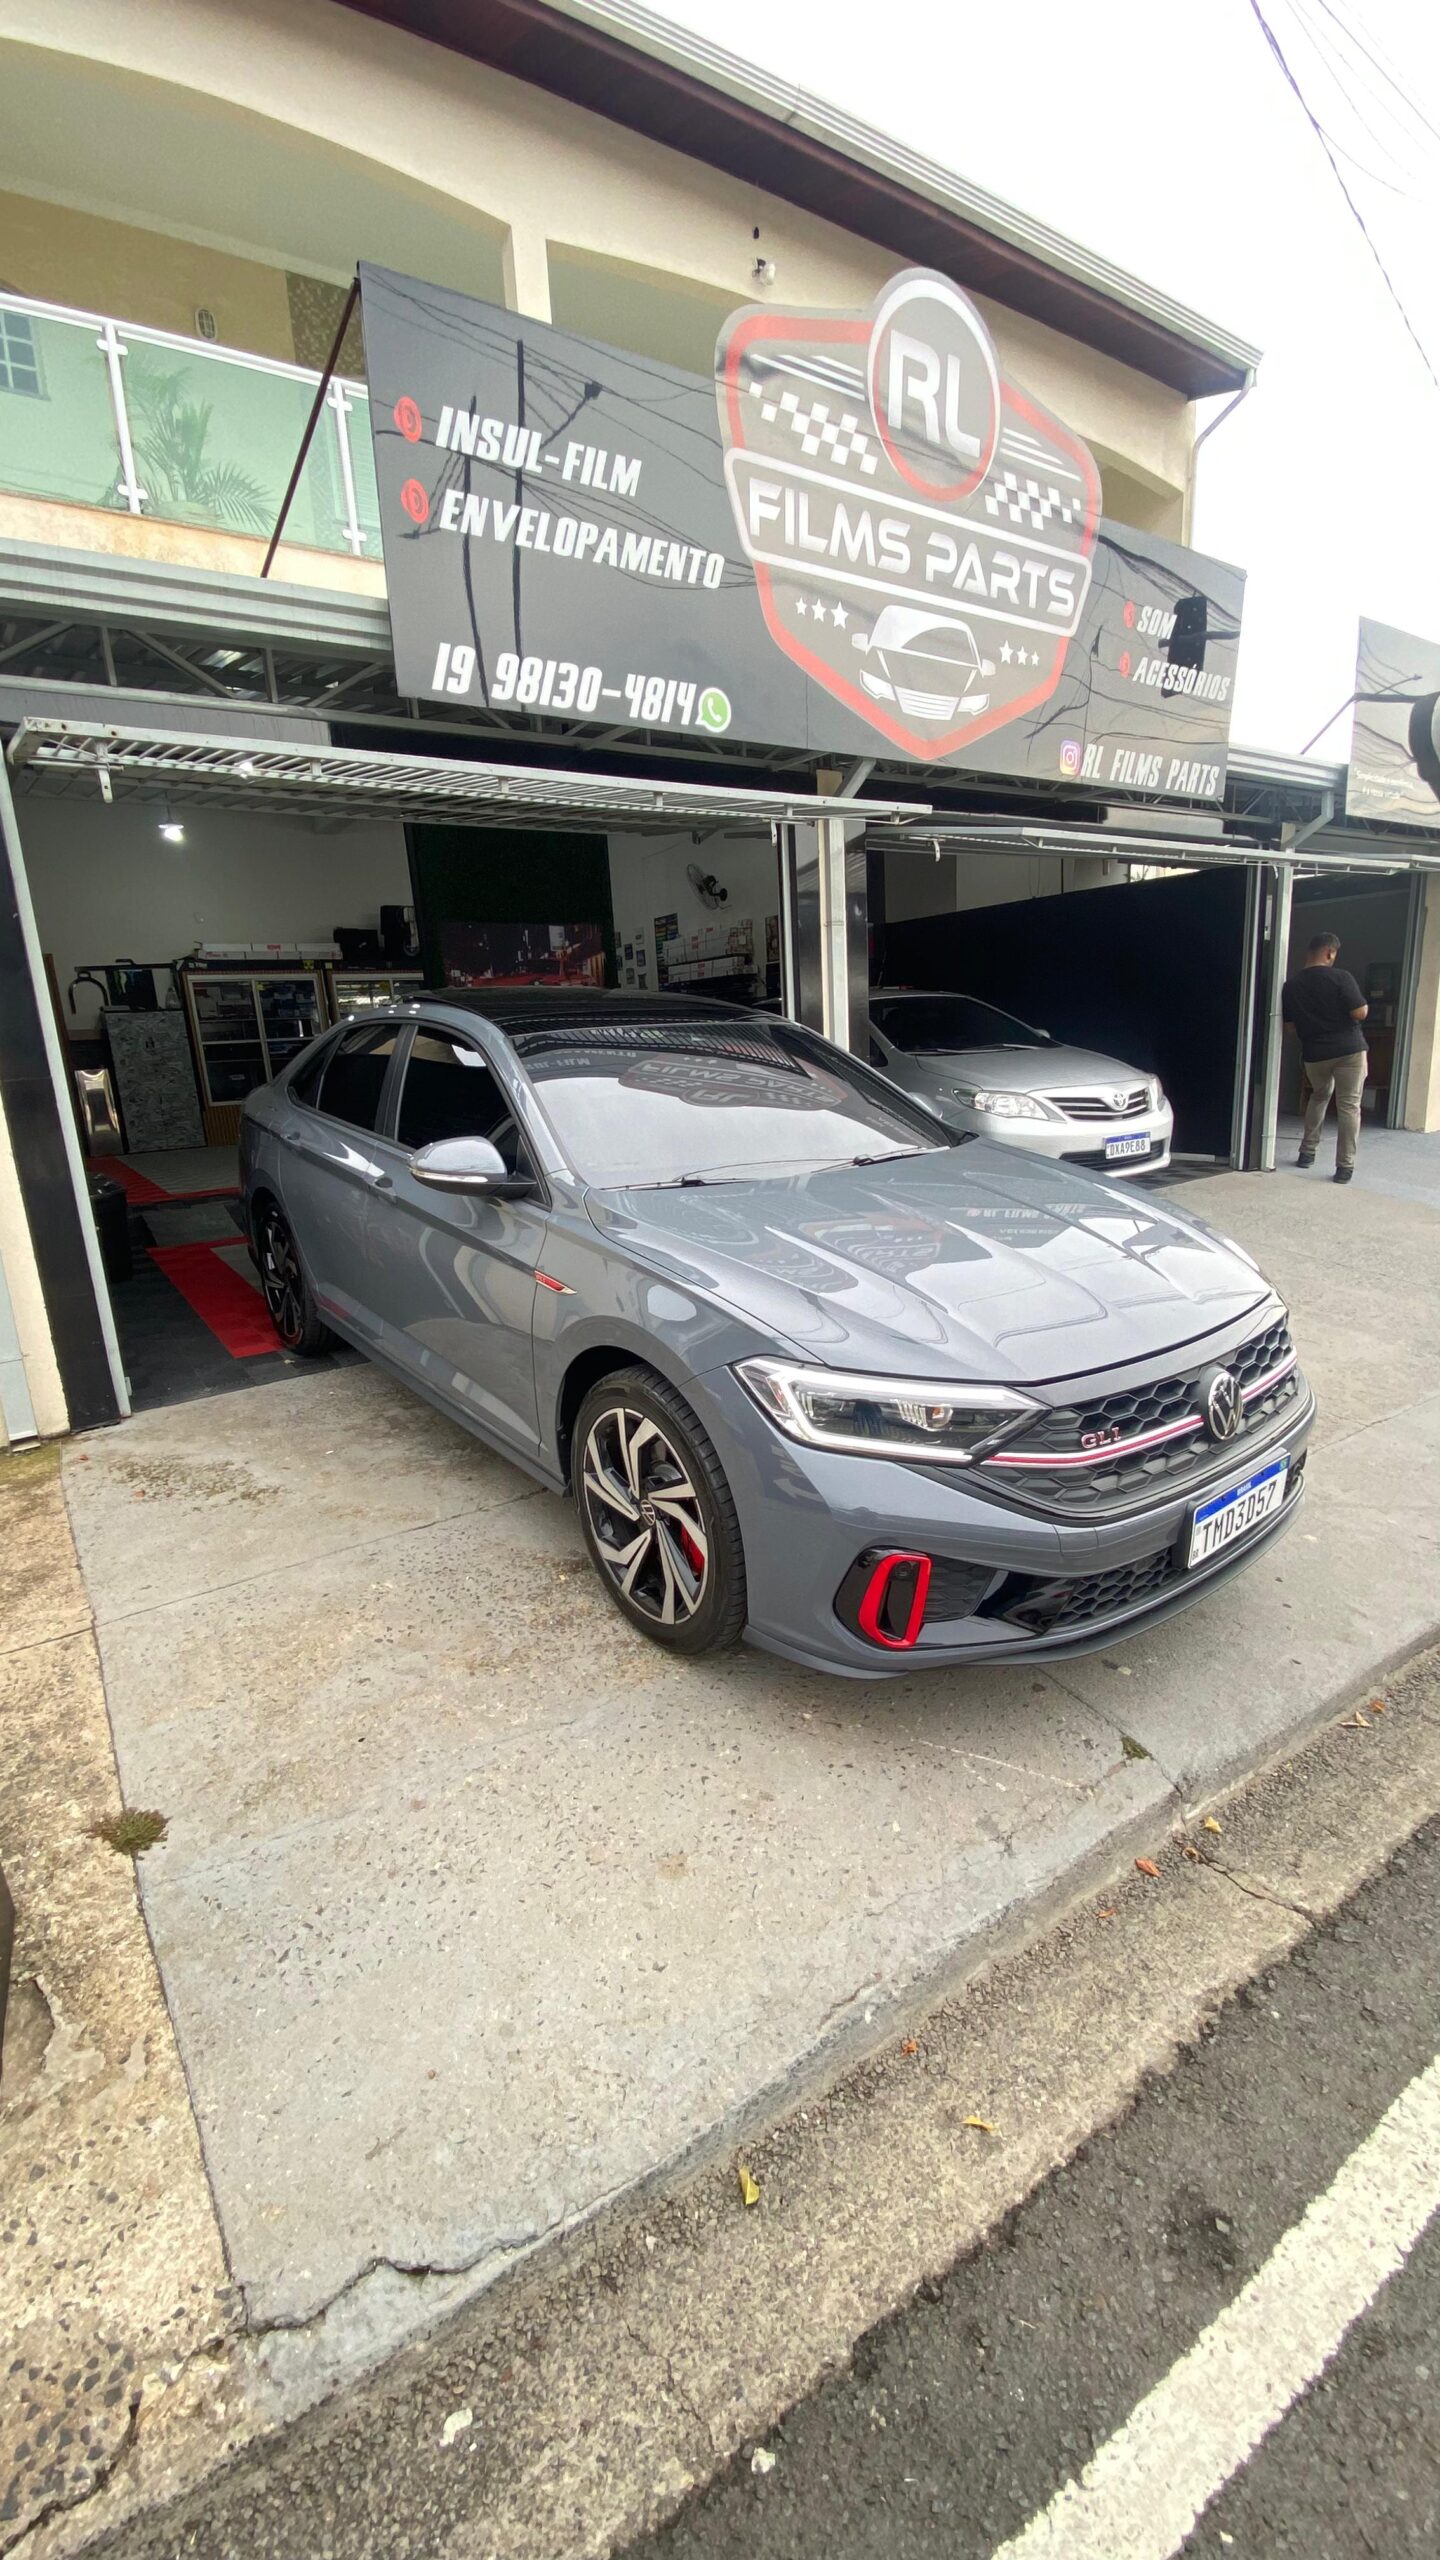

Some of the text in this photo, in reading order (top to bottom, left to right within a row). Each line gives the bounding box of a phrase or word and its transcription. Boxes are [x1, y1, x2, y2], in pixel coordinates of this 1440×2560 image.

[887, 329, 981, 459] RL
[435, 405, 643, 497] INSUL-FILM
[439, 489, 726, 590] ENVELOPAMENTO
[749, 477, 1076, 618] FILMS PARTS
[1136, 605, 1178, 640] SOM
[431, 642, 697, 726] 19 98130-4814
[1132, 656, 1231, 702] ACESSÓRIOS
[1080, 743, 1221, 796] RL FILMS PARTS
[1109, 1139, 1146, 1156] DXA9E88
[1080, 1427, 1122, 1450] GLI
[1202, 1479, 1278, 1554] TMD3D57
